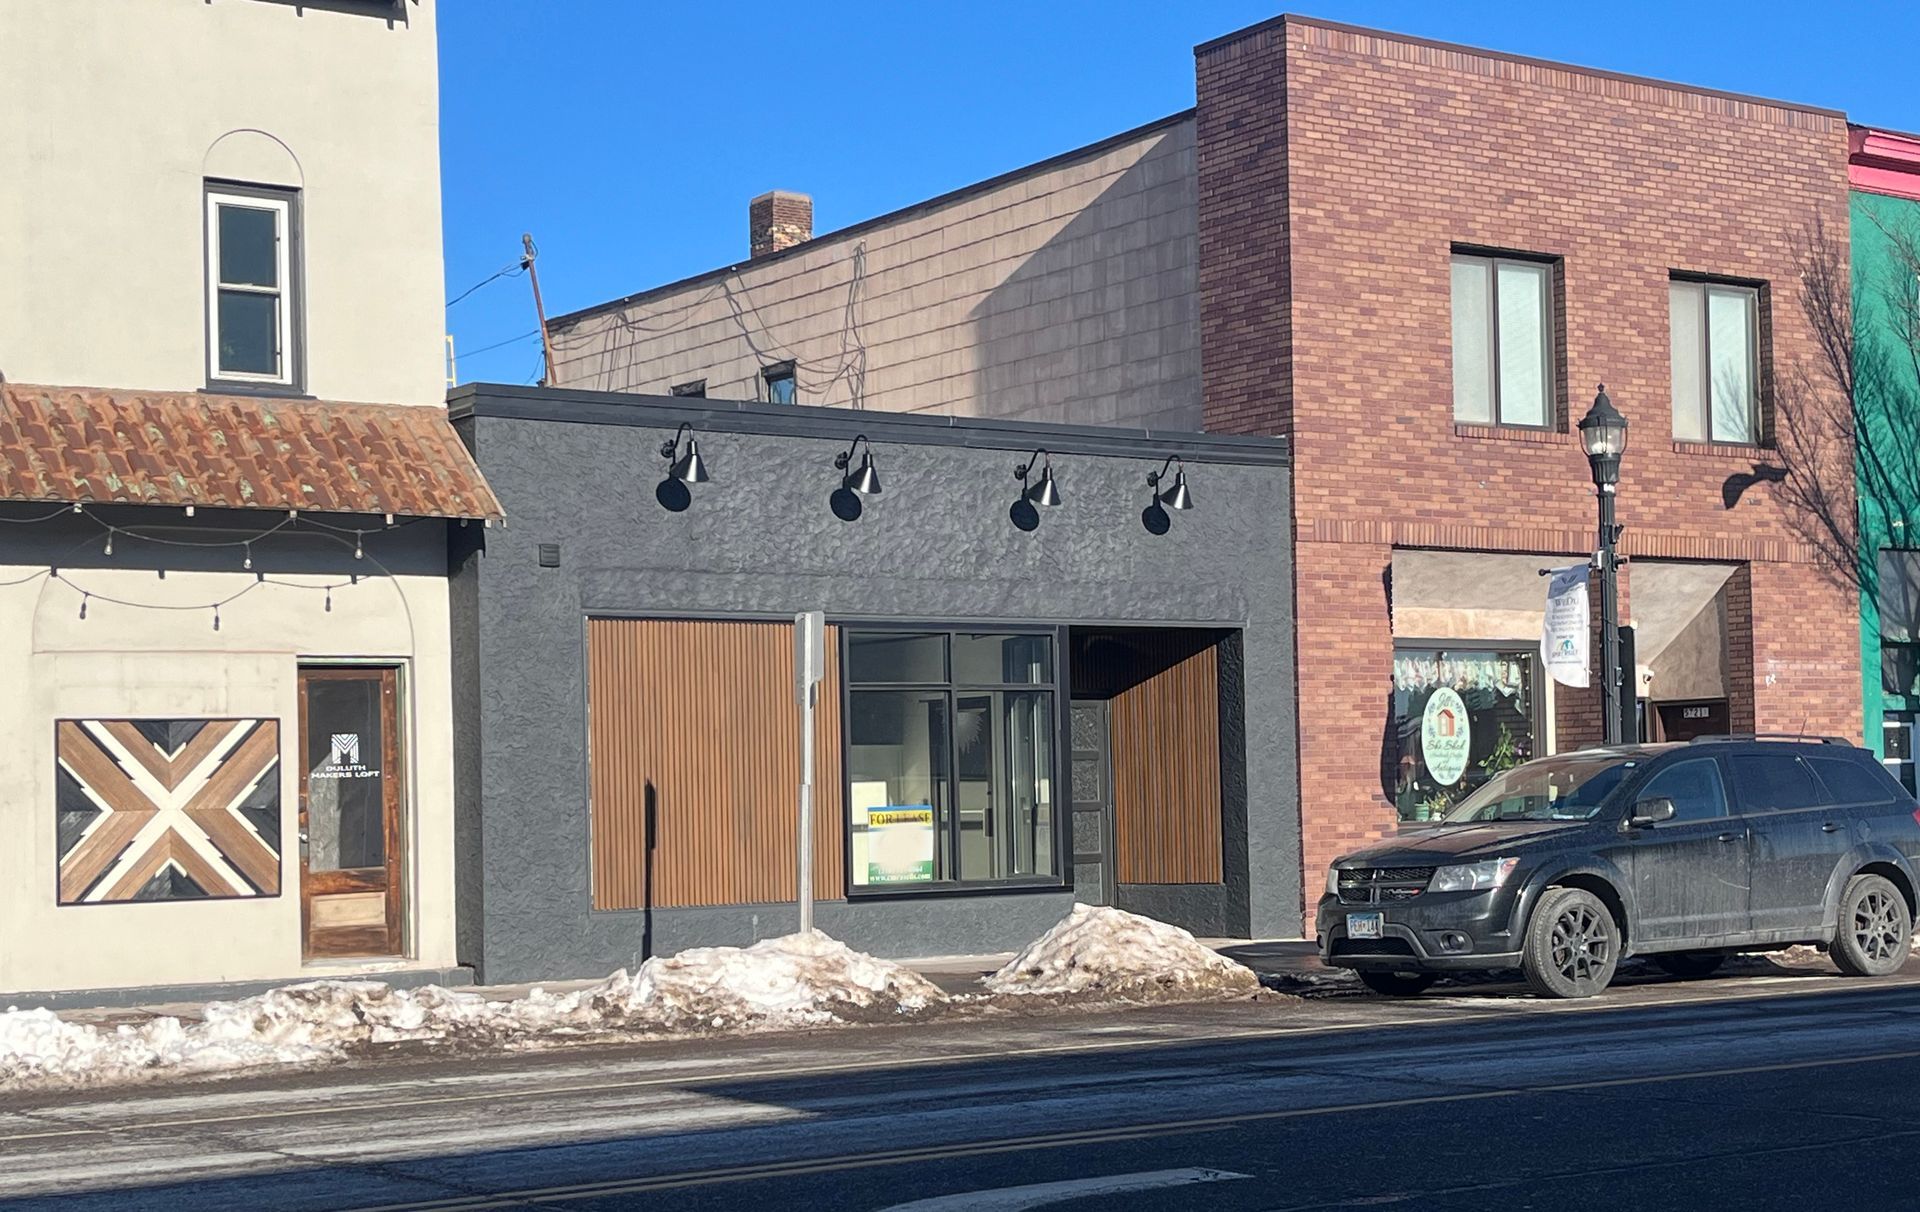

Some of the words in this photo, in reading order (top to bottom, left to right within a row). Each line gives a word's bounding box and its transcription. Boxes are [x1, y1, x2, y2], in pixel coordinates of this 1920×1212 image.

[325, 764, 366, 772] DULUTH
[311, 771, 352, 779] MAKERS
[355, 770, 380, 778] LOFT
[869, 813, 893, 825] FOR
